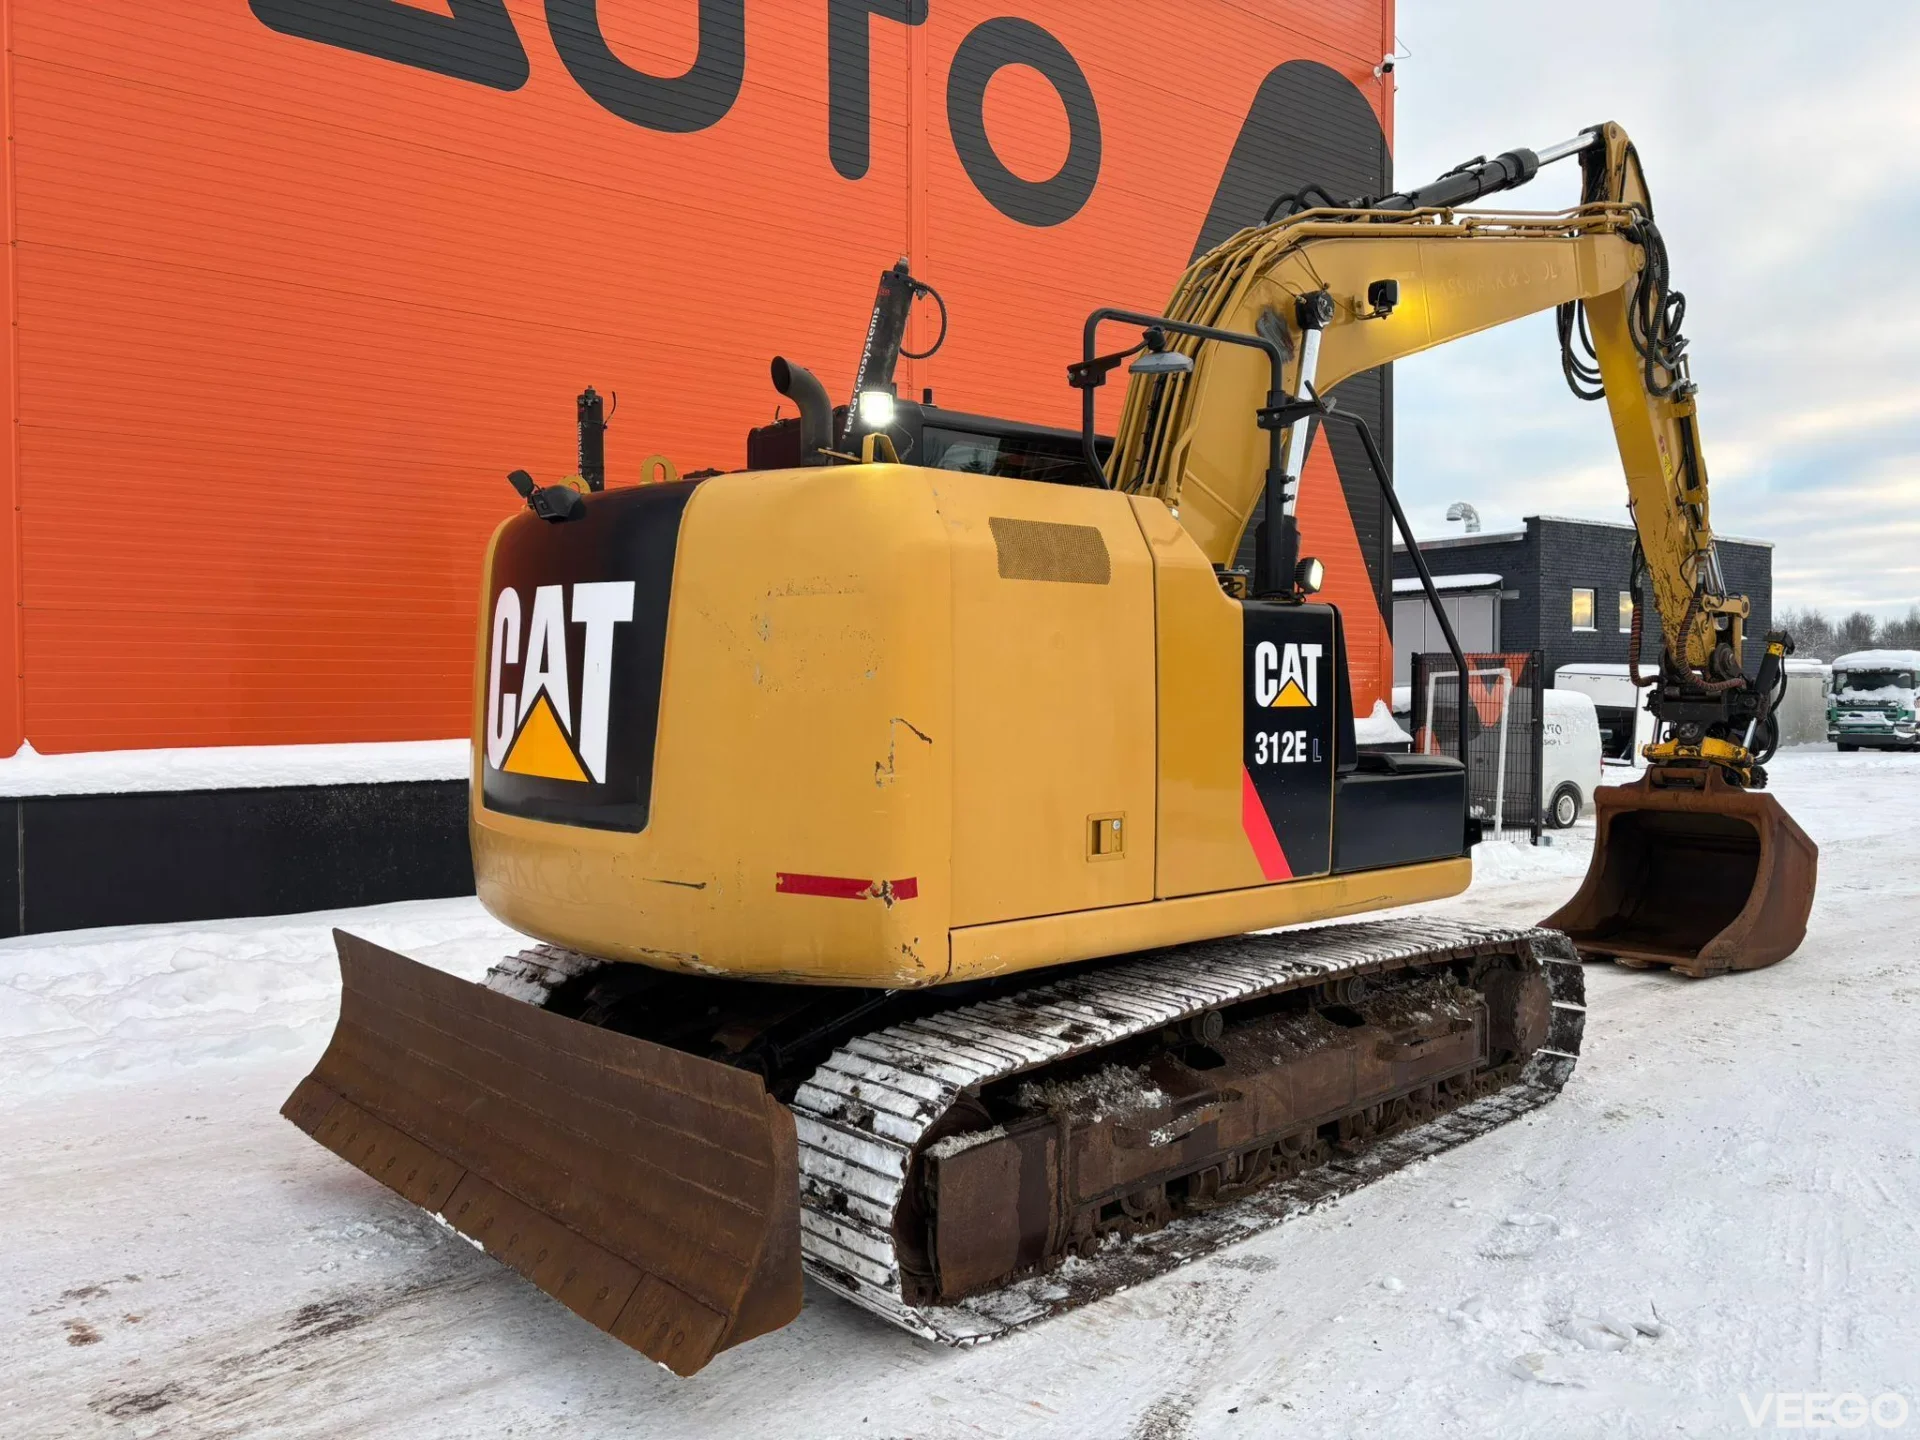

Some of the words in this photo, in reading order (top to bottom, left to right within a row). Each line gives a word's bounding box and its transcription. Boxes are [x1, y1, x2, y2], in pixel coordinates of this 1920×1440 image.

[853, 307, 881, 393] Geosystems
[487, 580, 636, 784] CAT
[1254, 640, 1323, 708] CAT
[1254, 730, 1307, 765] 312E
[1312, 738, 1322, 762] L
